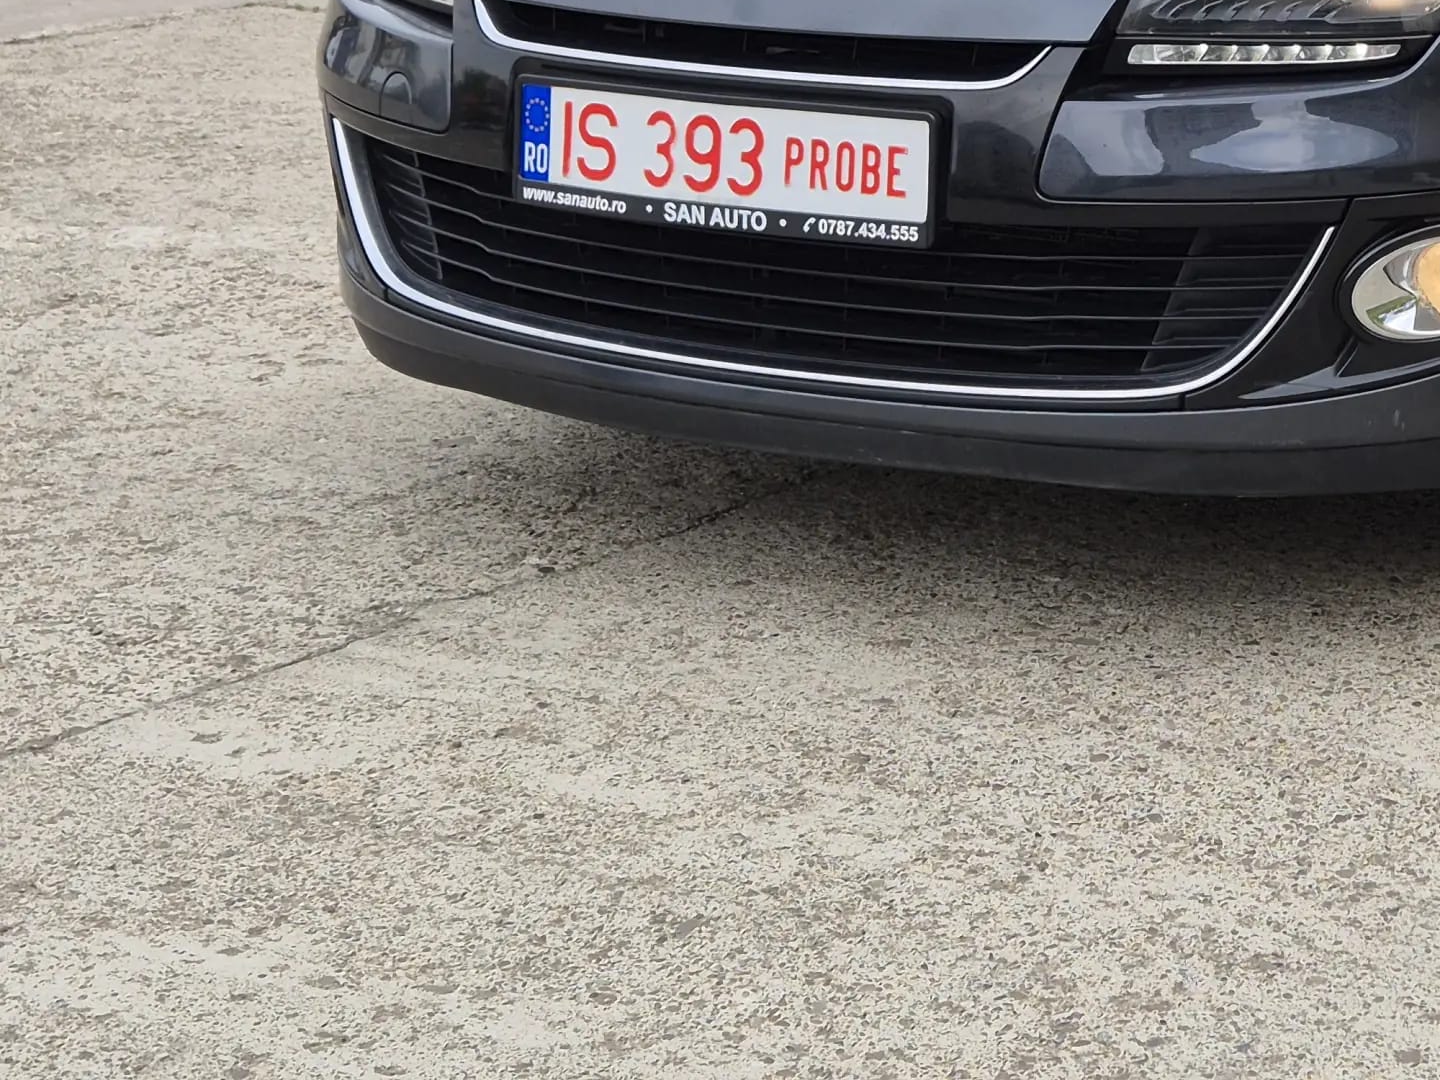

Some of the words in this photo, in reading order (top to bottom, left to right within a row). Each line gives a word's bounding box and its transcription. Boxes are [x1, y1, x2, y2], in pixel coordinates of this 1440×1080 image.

[523, 141, 548, 174] RO
[562, 101, 618, 182] IS
[643, 110, 765, 197] 393
[784, 136, 909, 199] PROBE
[522, 186, 627, 215] www.sanauto.ro
[663, 202, 705, 226] SAN
[709, 207, 767, 232] AUTO
[818, 218, 919, 242] 0787.434.555
